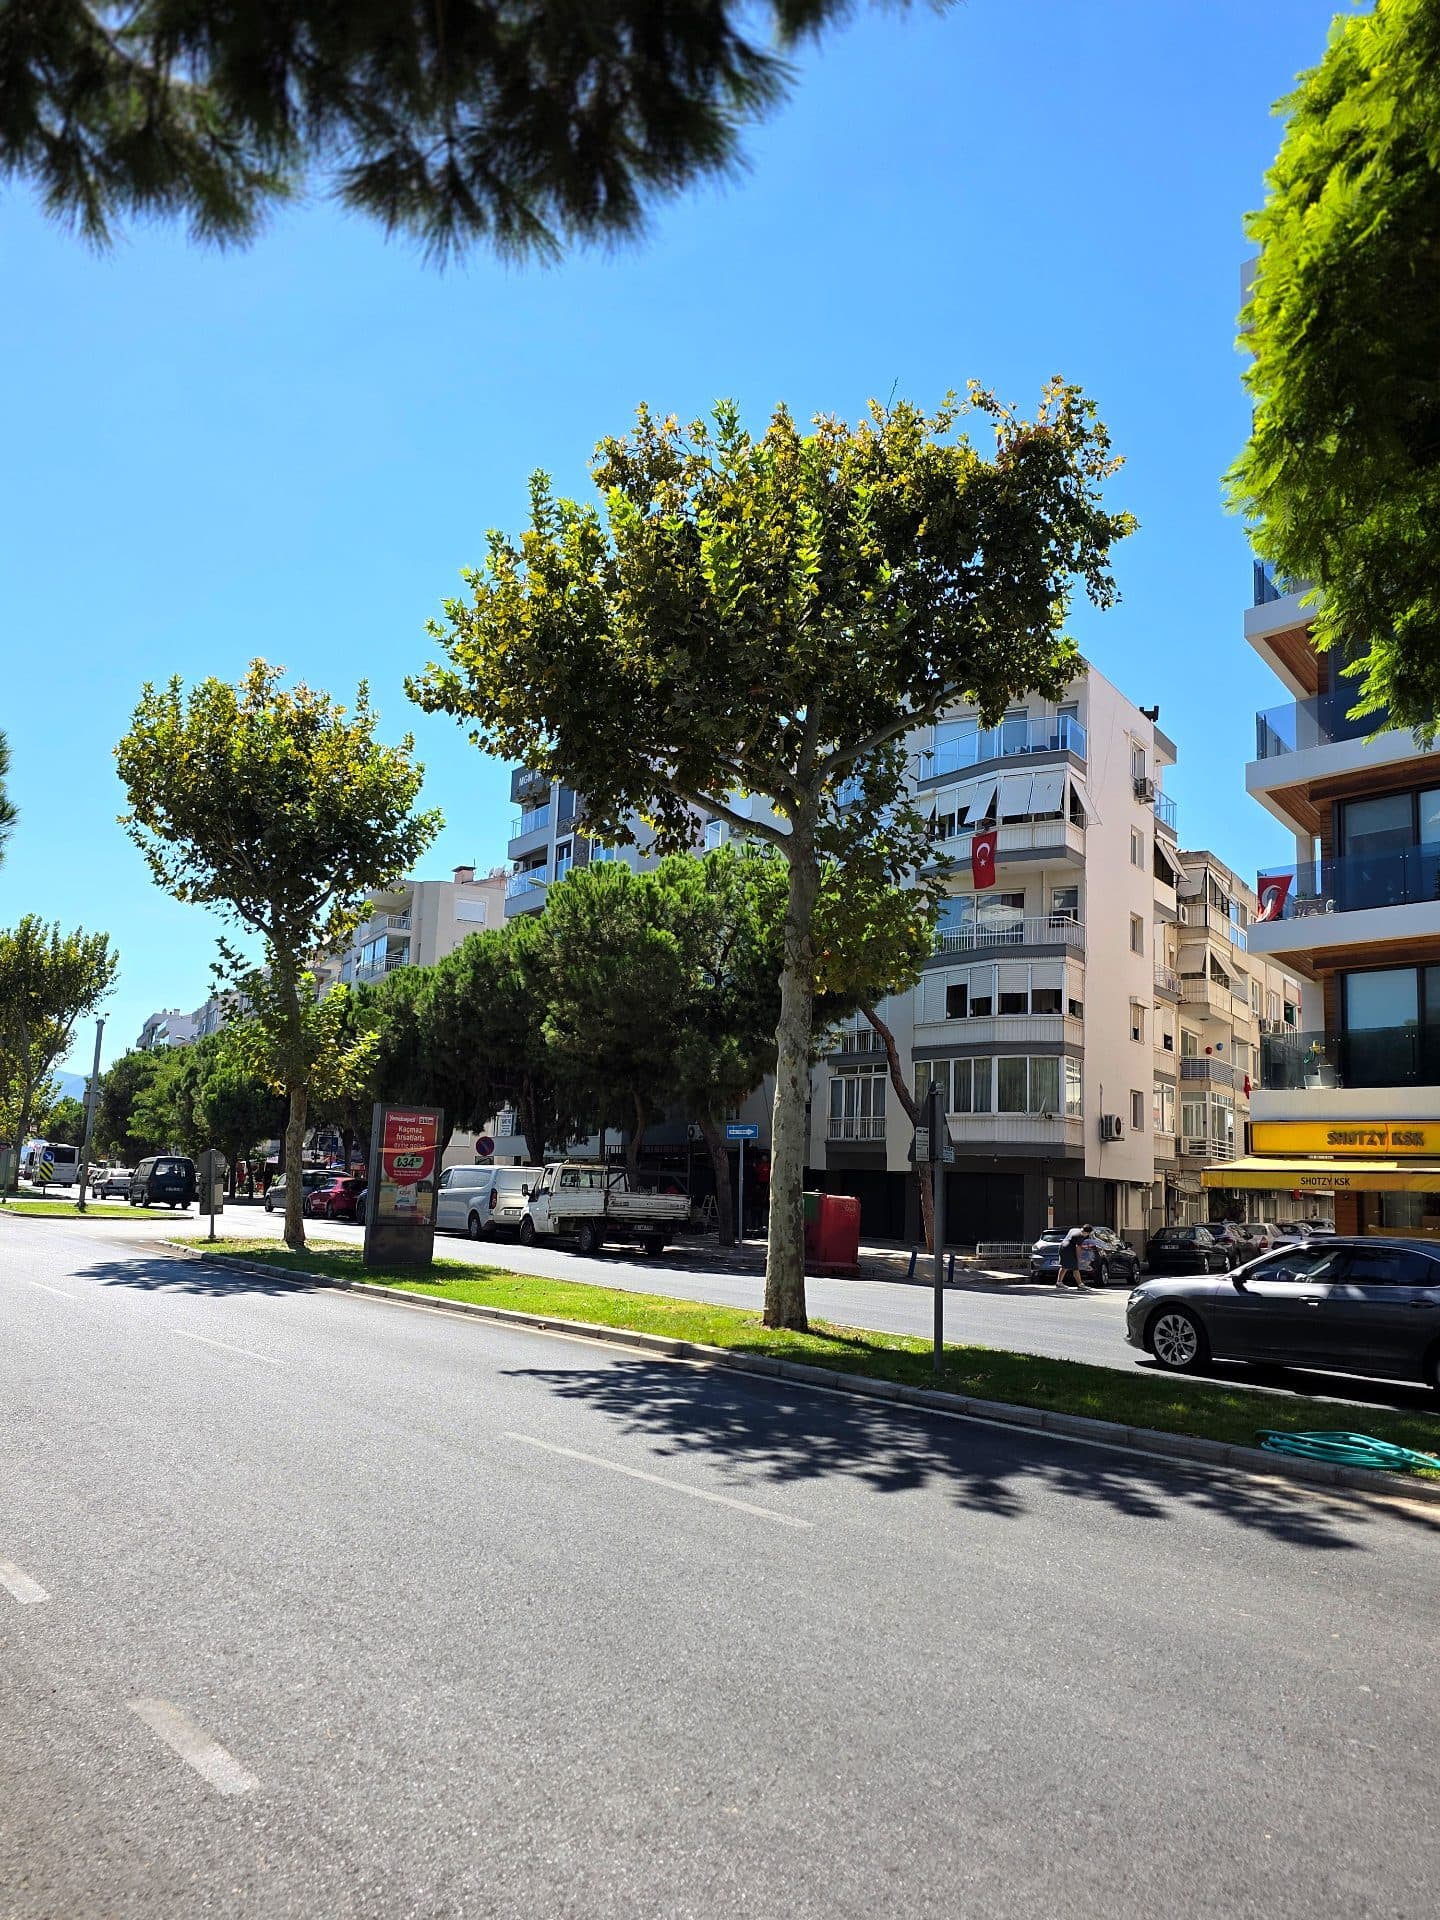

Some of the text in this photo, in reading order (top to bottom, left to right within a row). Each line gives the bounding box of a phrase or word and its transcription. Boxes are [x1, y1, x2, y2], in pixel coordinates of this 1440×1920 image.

[398, 1125, 423, 1134] Kaçmaz
[1327, 1131, 1425, 1146] SHOTZY KSK
[1300, 1176, 1351, 1186] SHOTZY KSK
